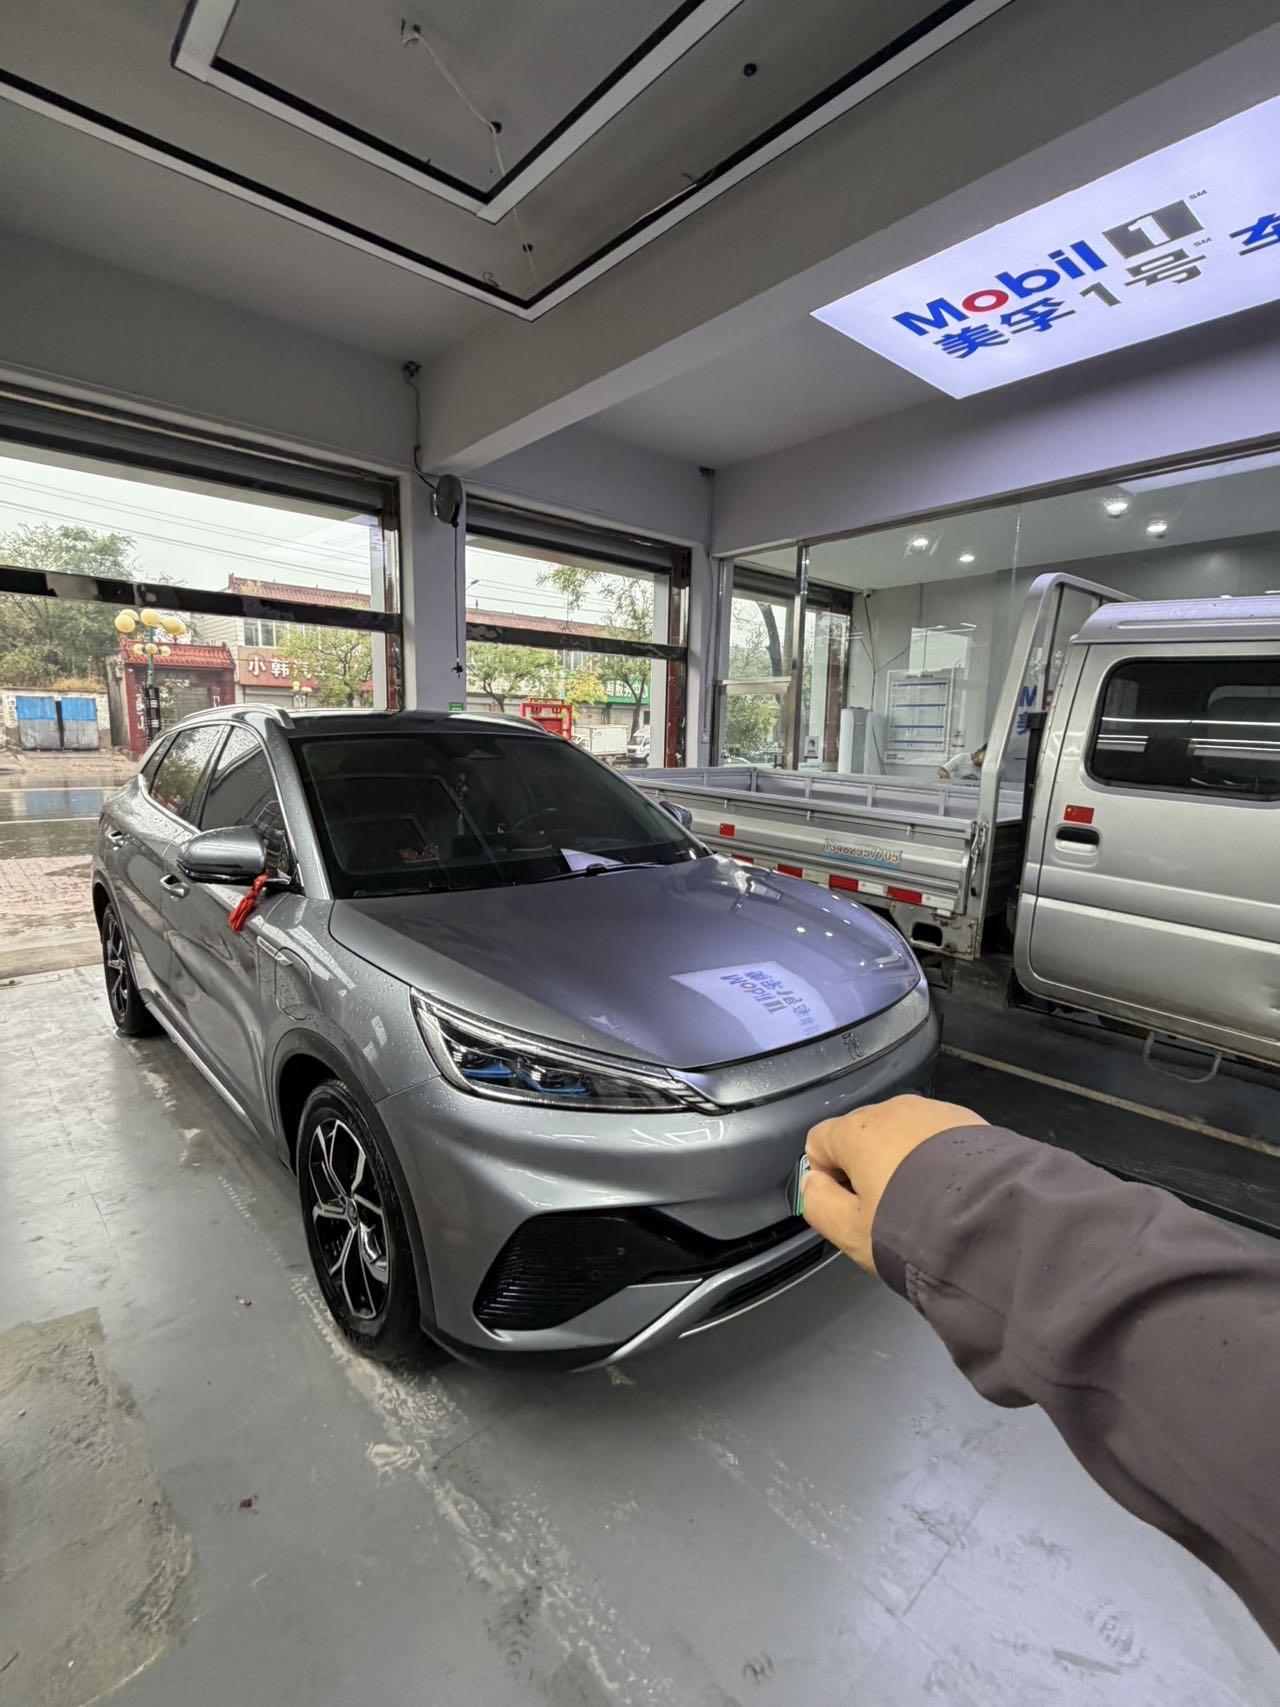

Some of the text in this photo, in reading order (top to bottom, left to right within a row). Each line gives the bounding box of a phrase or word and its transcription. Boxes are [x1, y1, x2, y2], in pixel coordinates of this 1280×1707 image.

[892, 240, 1107, 337] Mobil
[933, 248, 1207, 359] 美孚1号
